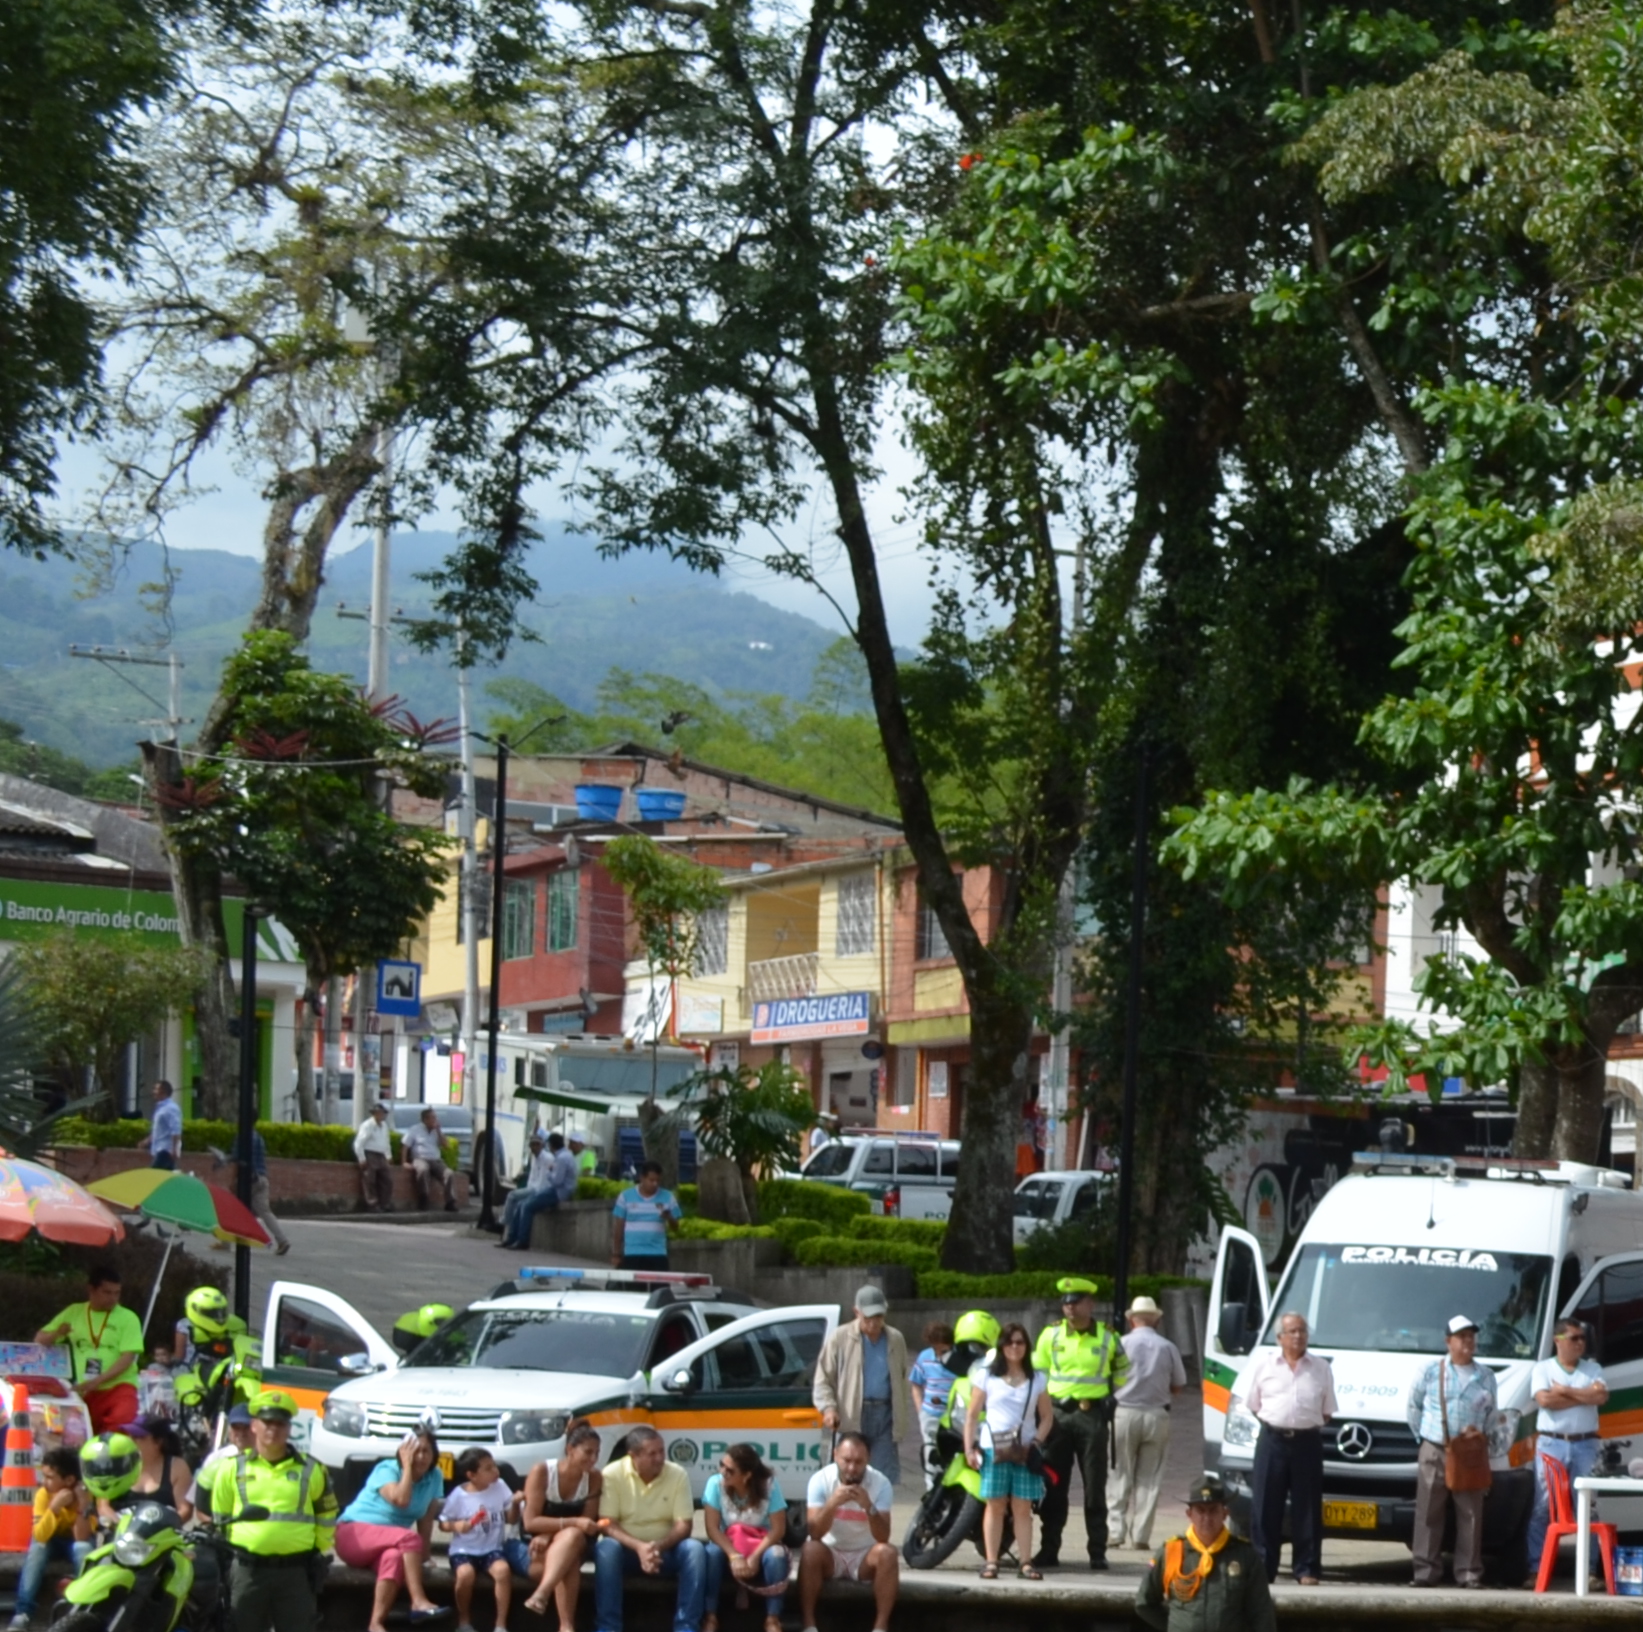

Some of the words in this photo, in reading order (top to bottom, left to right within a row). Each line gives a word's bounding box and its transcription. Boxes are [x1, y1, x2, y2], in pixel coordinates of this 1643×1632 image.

[7, 901, 53, 922] Banco
[56, 906, 110, 928] Agrario
[112, 911, 131, 928] de
[135, 911, 180, 932] Colom
[777, 995, 863, 1025] DROGUERIA
[703, 1441, 821, 1461] PLIC
